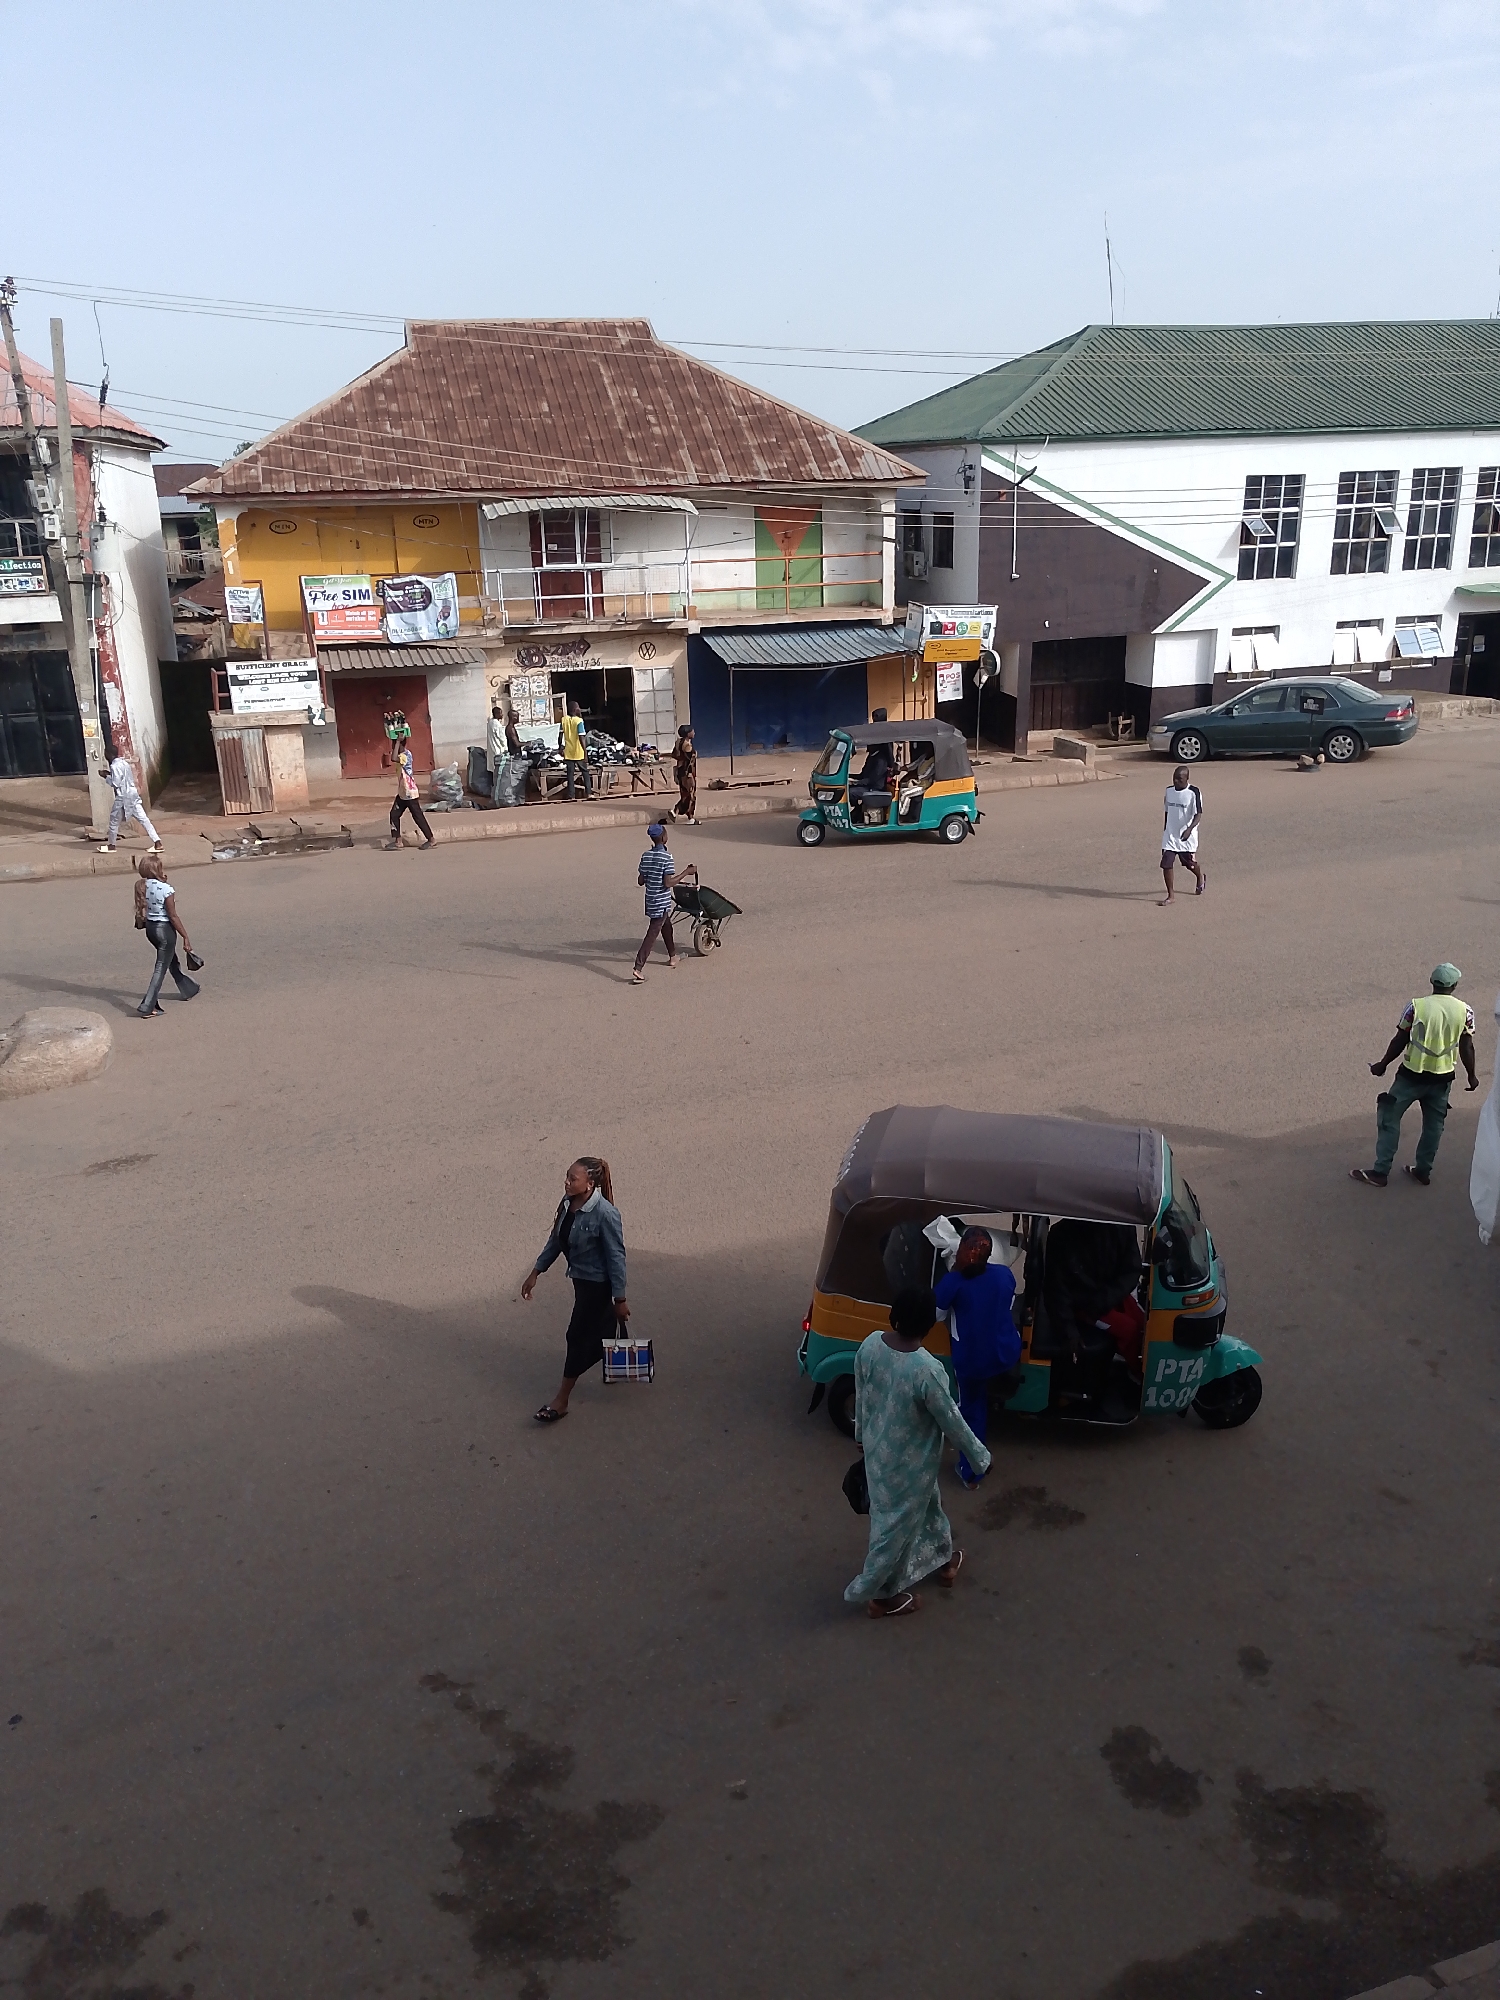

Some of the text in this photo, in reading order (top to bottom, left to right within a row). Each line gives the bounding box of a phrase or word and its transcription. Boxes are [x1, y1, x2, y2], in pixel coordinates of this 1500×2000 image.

[309, 590, 338, 605] Free
[342, 589, 371, 600] SIM
[236, 662, 280, 670] SUFFICIENT
[945, 672, 960, 680] POS
